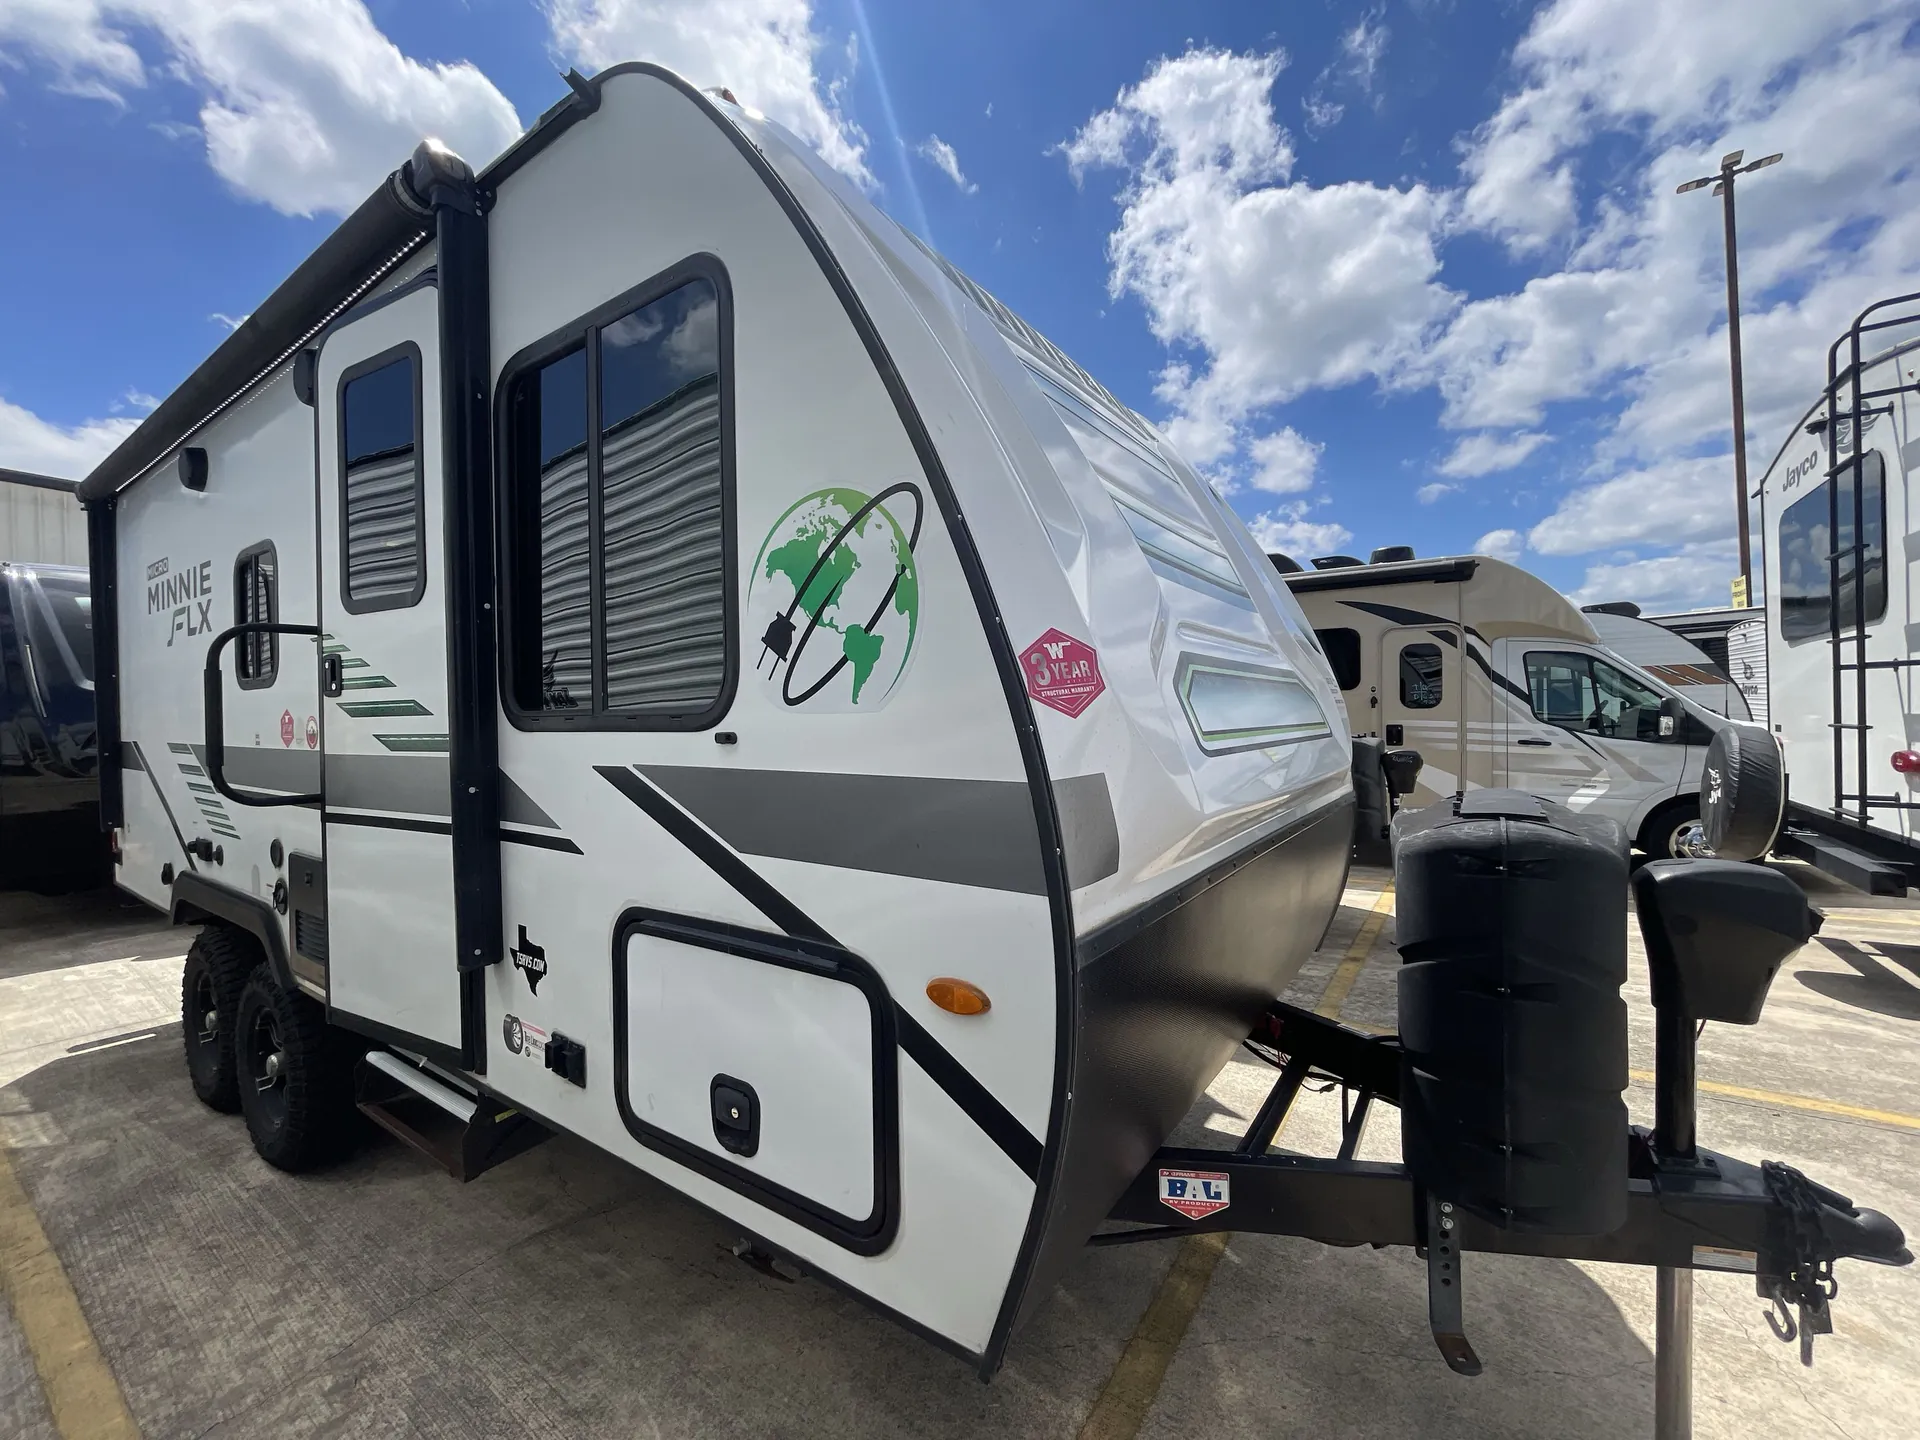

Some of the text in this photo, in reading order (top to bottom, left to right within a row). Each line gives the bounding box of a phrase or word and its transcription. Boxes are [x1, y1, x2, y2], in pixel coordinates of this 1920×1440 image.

[1782, 450, 1818, 492] Jayco
[147, 560, 212, 615] MINNIE
[167, 598, 212, 647] FLX
[1030, 652, 1091, 686] 3 YEAR
[1041, 685, 1095, 697] STRUCTURAL WARRANTY
[1167, 1178, 1222, 1201] BAL
